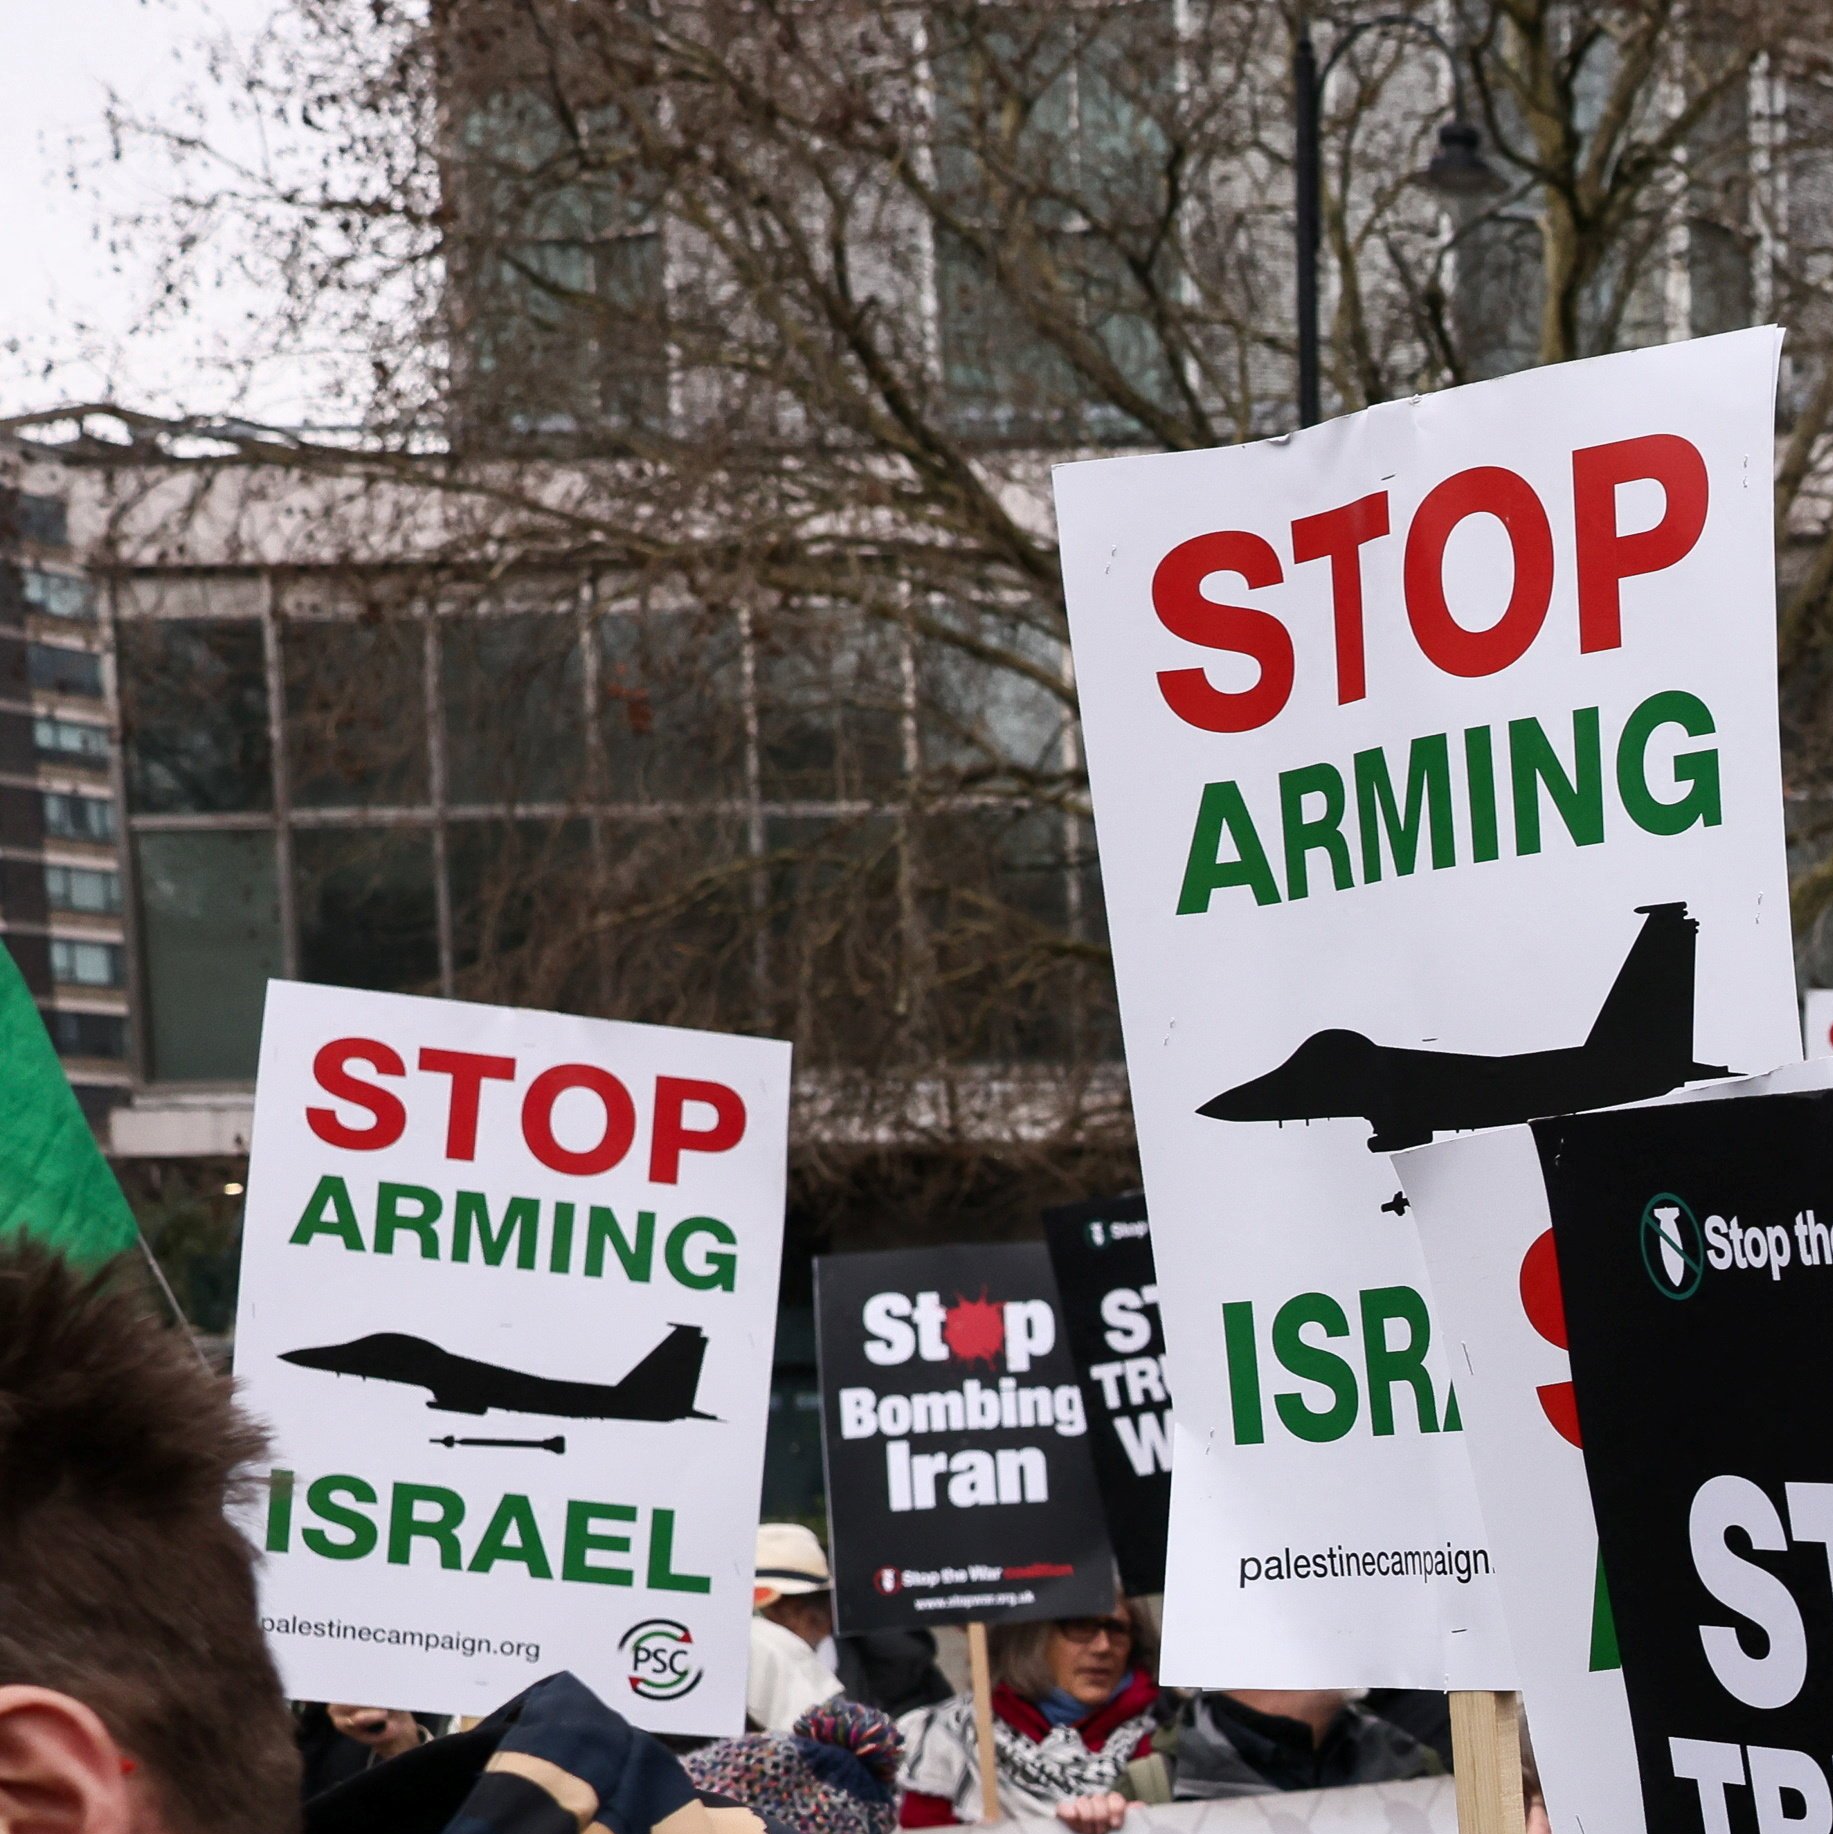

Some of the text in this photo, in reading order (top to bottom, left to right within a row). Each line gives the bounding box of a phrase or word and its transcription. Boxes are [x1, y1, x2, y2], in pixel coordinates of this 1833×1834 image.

[1153, 434, 1709, 732] STOP
[1176, 690, 1722, 915] ARMING
[305, 1036, 747, 1185] STOP
[288, 1174, 739, 1292] ARMING
[1704, 1215, 1790, 1281] Stop
[863, 1291, 1056, 1372] Stop
[1222, 1285, 1463, 1446] ISR
[839, 1378, 1087, 1439] Bombing
[886, 1441, 1049, 1511] Iran
[265, 1468, 711, 1593] ISRAEL
[902, 1569, 940, 1588] Stop
[968, 1564, 1003, 1582] War
[262, 1615, 541, 1663] palestinecampaign.org
[634, 1646, 688, 1676] PSC
